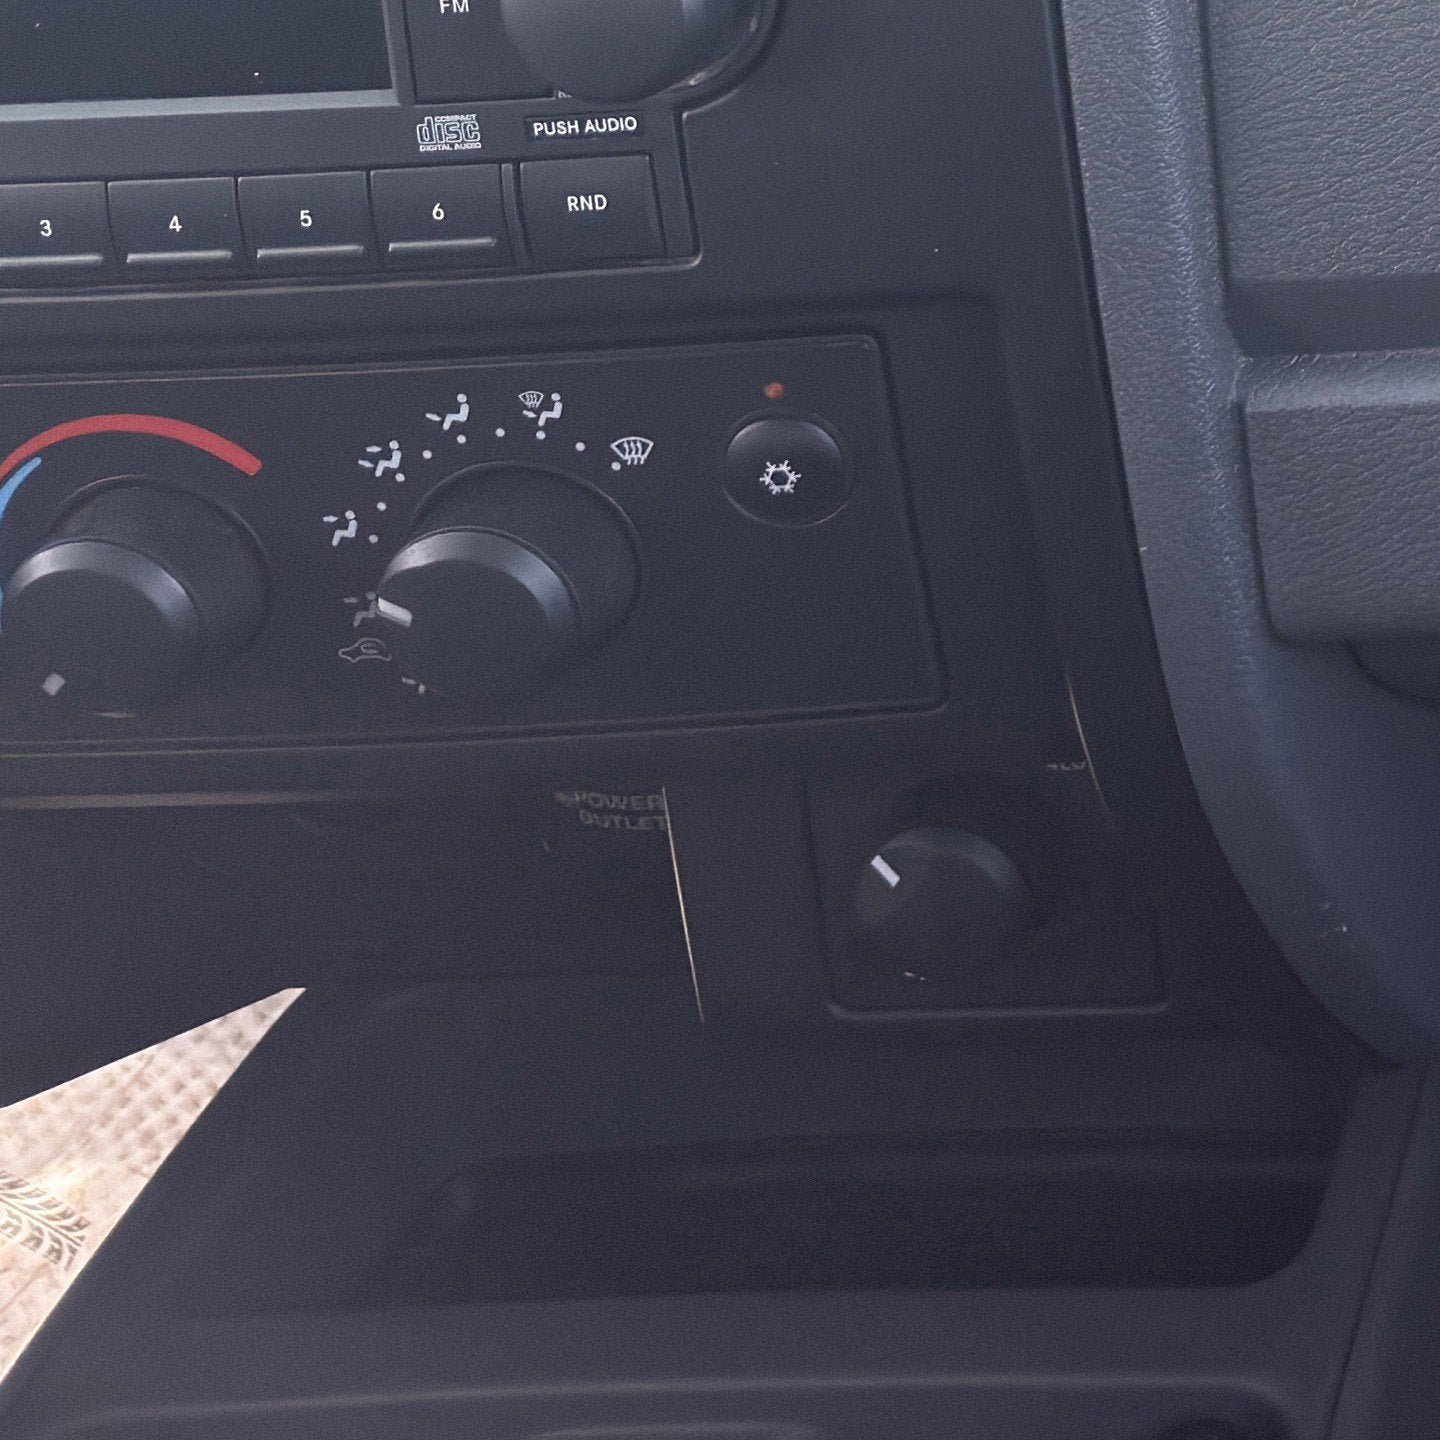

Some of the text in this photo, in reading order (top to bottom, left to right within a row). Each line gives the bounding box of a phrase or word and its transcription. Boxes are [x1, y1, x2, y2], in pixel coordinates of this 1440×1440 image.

[532, 116, 637, 137] PUSH AUDIO
[431, 203, 445, 222] 6
[567, 194, 608, 214] RND
[40, 219, 53, 239] 3
[169, 216, 182, 234] 4
[300, 210, 313, 230] 5
